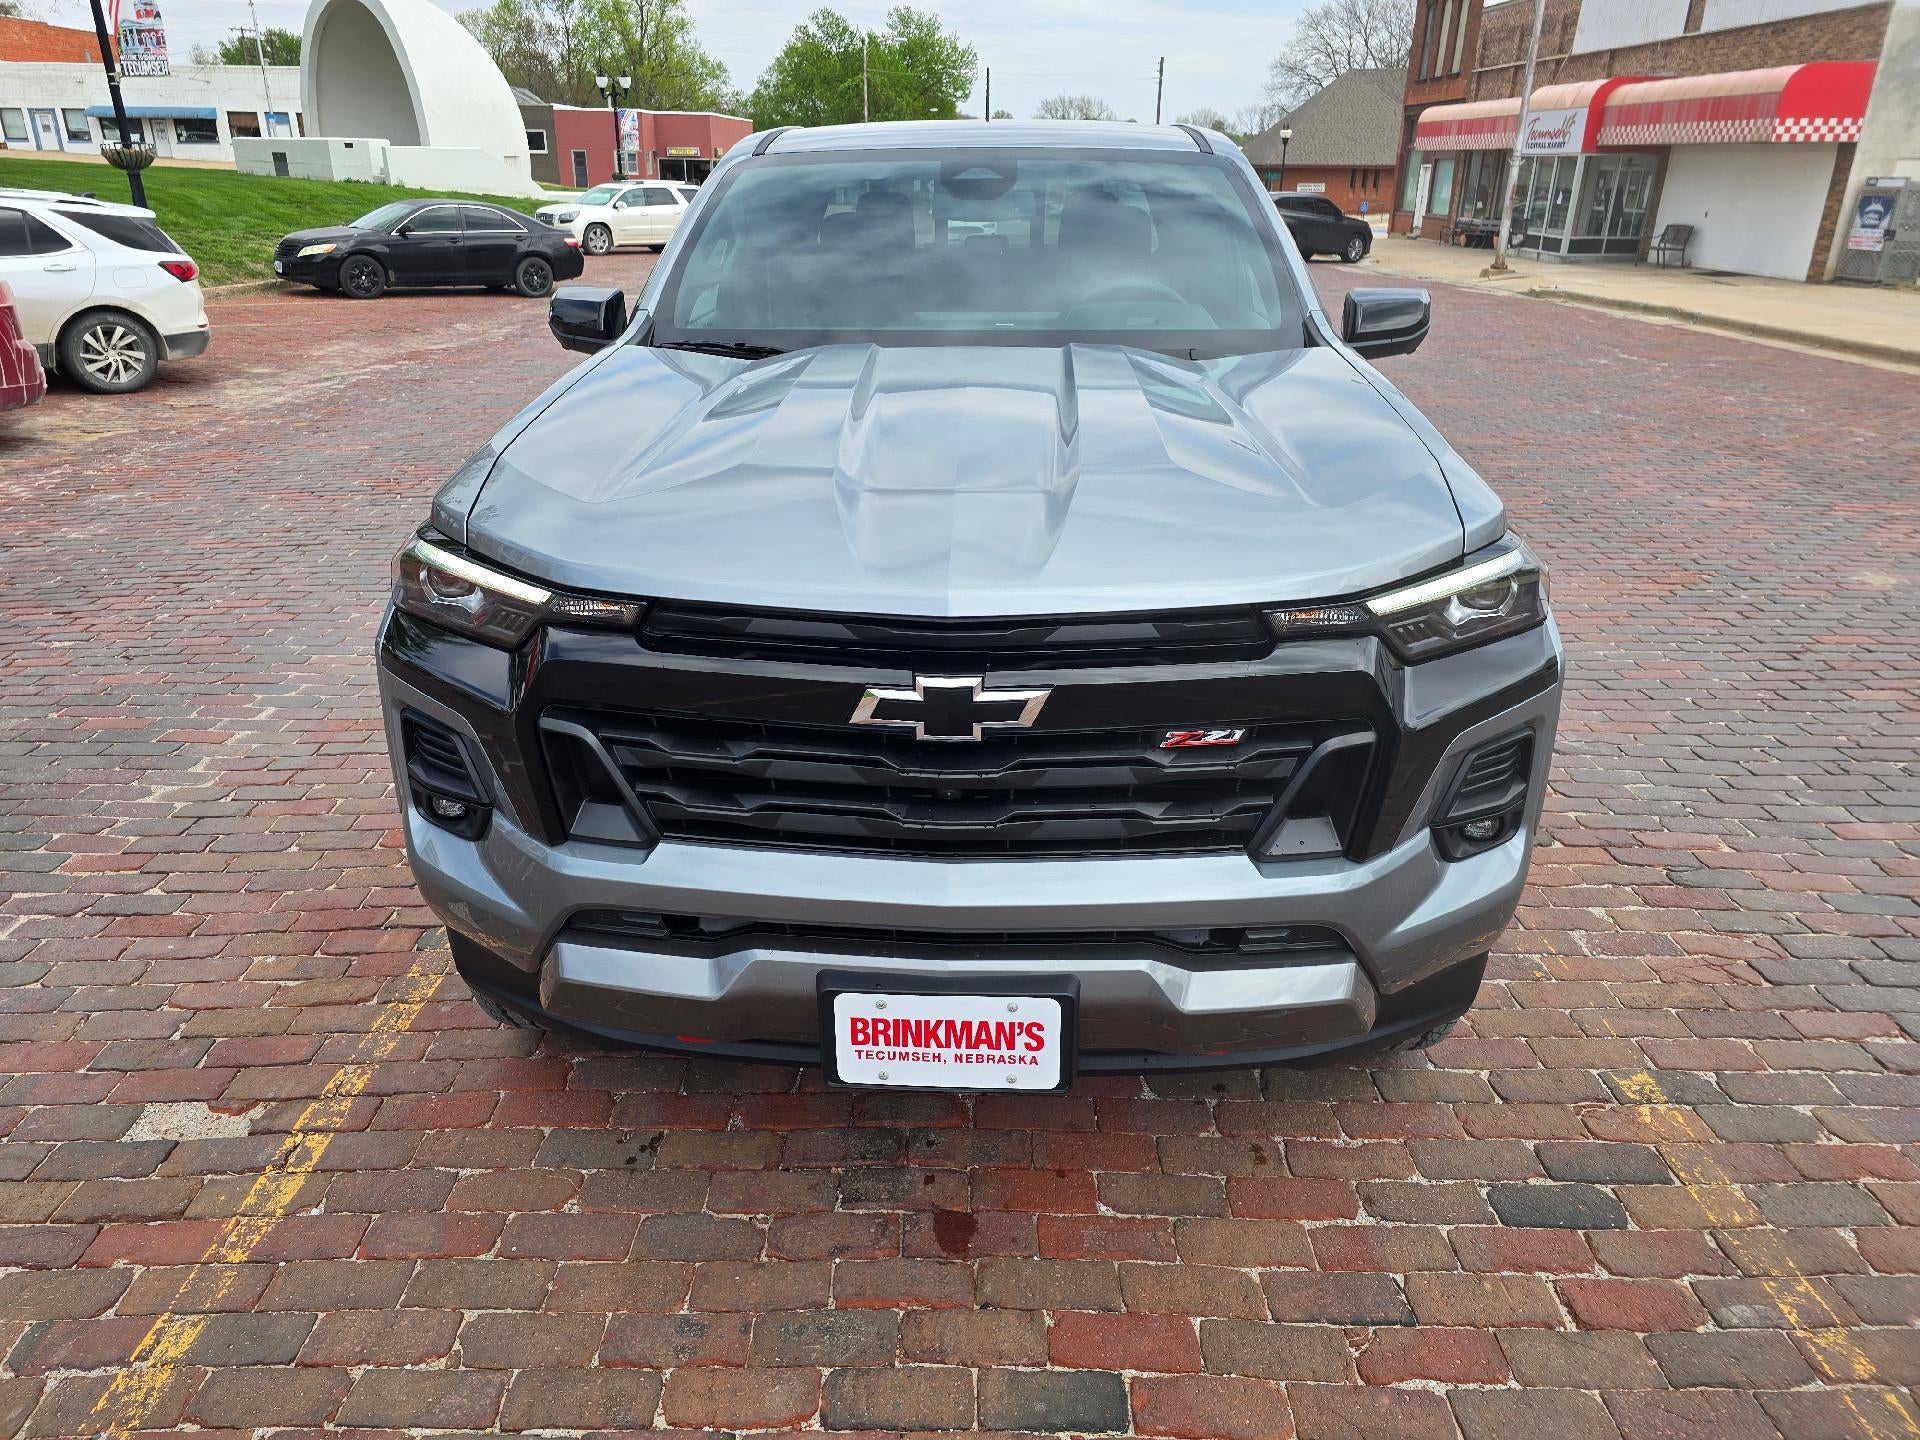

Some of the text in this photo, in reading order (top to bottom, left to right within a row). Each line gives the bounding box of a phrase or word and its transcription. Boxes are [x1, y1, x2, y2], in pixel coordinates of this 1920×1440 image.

[121, 60, 169, 76] TECUMSEH
[1547, 141, 1566, 149] MARKET
[1160, 729, 1245, 748] Z71
[850, 1016, 1045, 1052] BRINKMAN'S
[855, 1049, 1039, 1065] TECUMSEH, NEBRASKA
